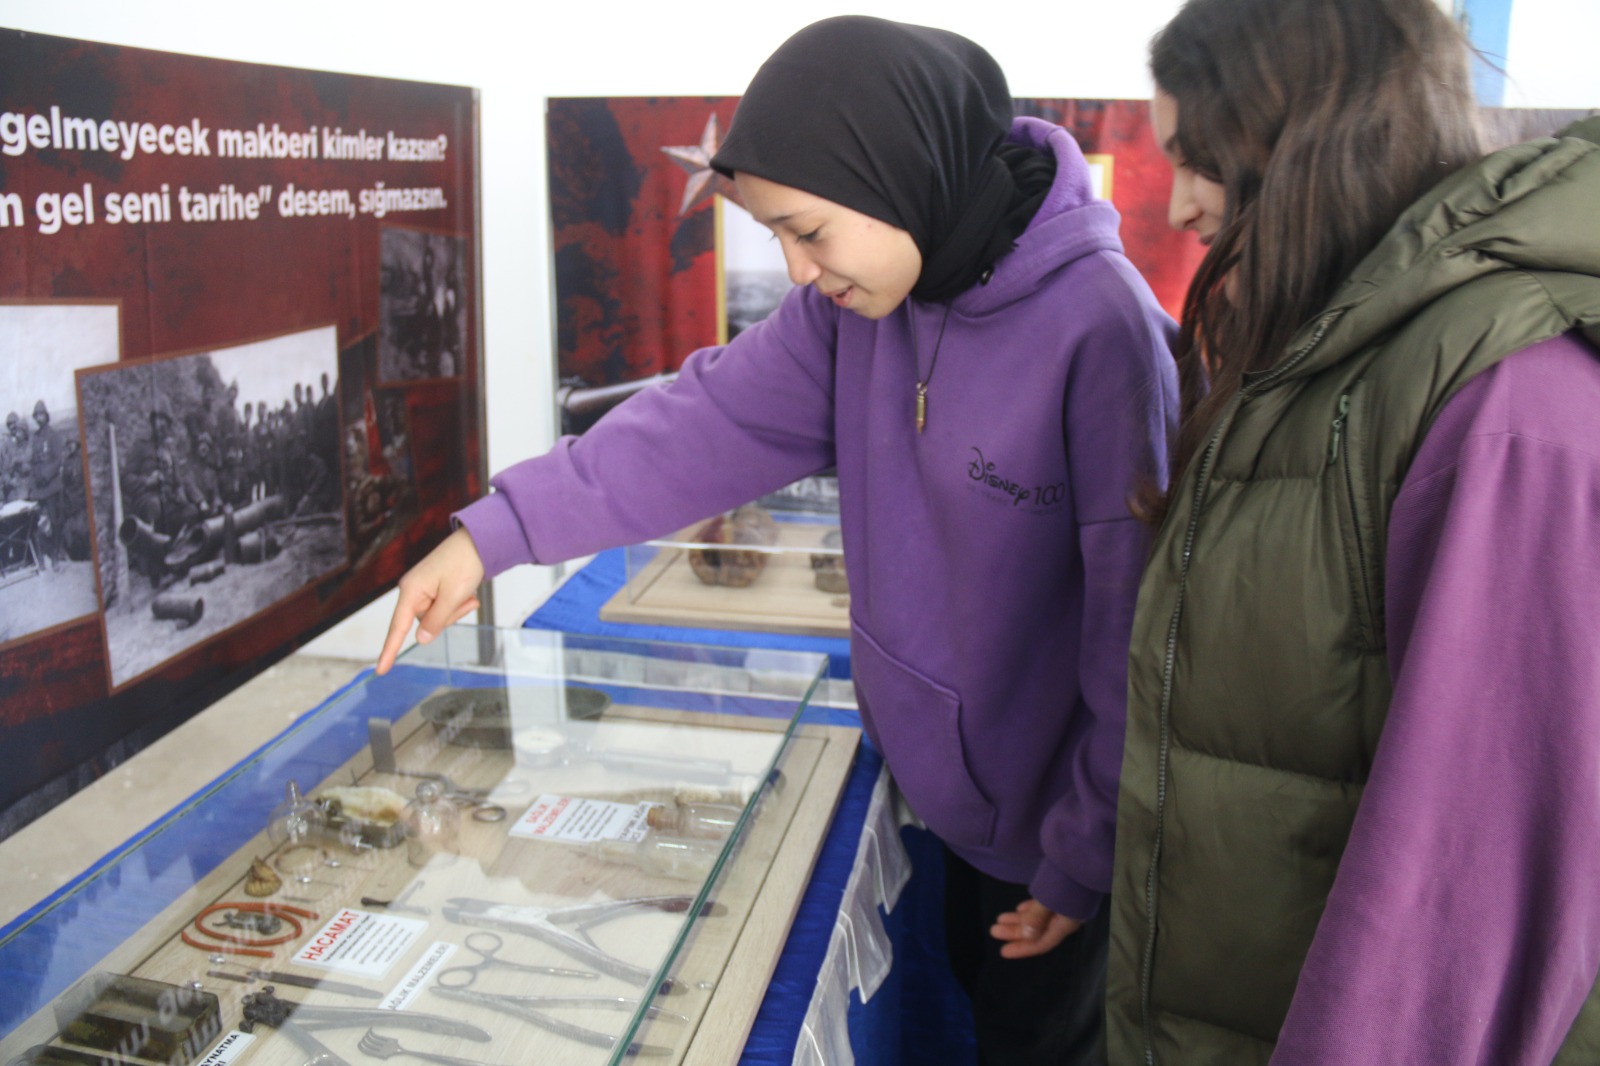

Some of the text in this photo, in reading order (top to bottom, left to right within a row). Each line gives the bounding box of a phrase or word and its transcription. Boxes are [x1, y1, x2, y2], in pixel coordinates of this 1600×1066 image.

[0, 105, 211, 160] gelmeyecek
[217, 123, 318, 160] makberi
[322, 126, 384, 162] kimler
[37, 183, 95, 235] gel
[105, 184, 171, 225] seni
[279, 183, 356, 220] desem,
[1034, 482, 1066, 506] 100
[300, 910, 359, 961] HACAMAT
